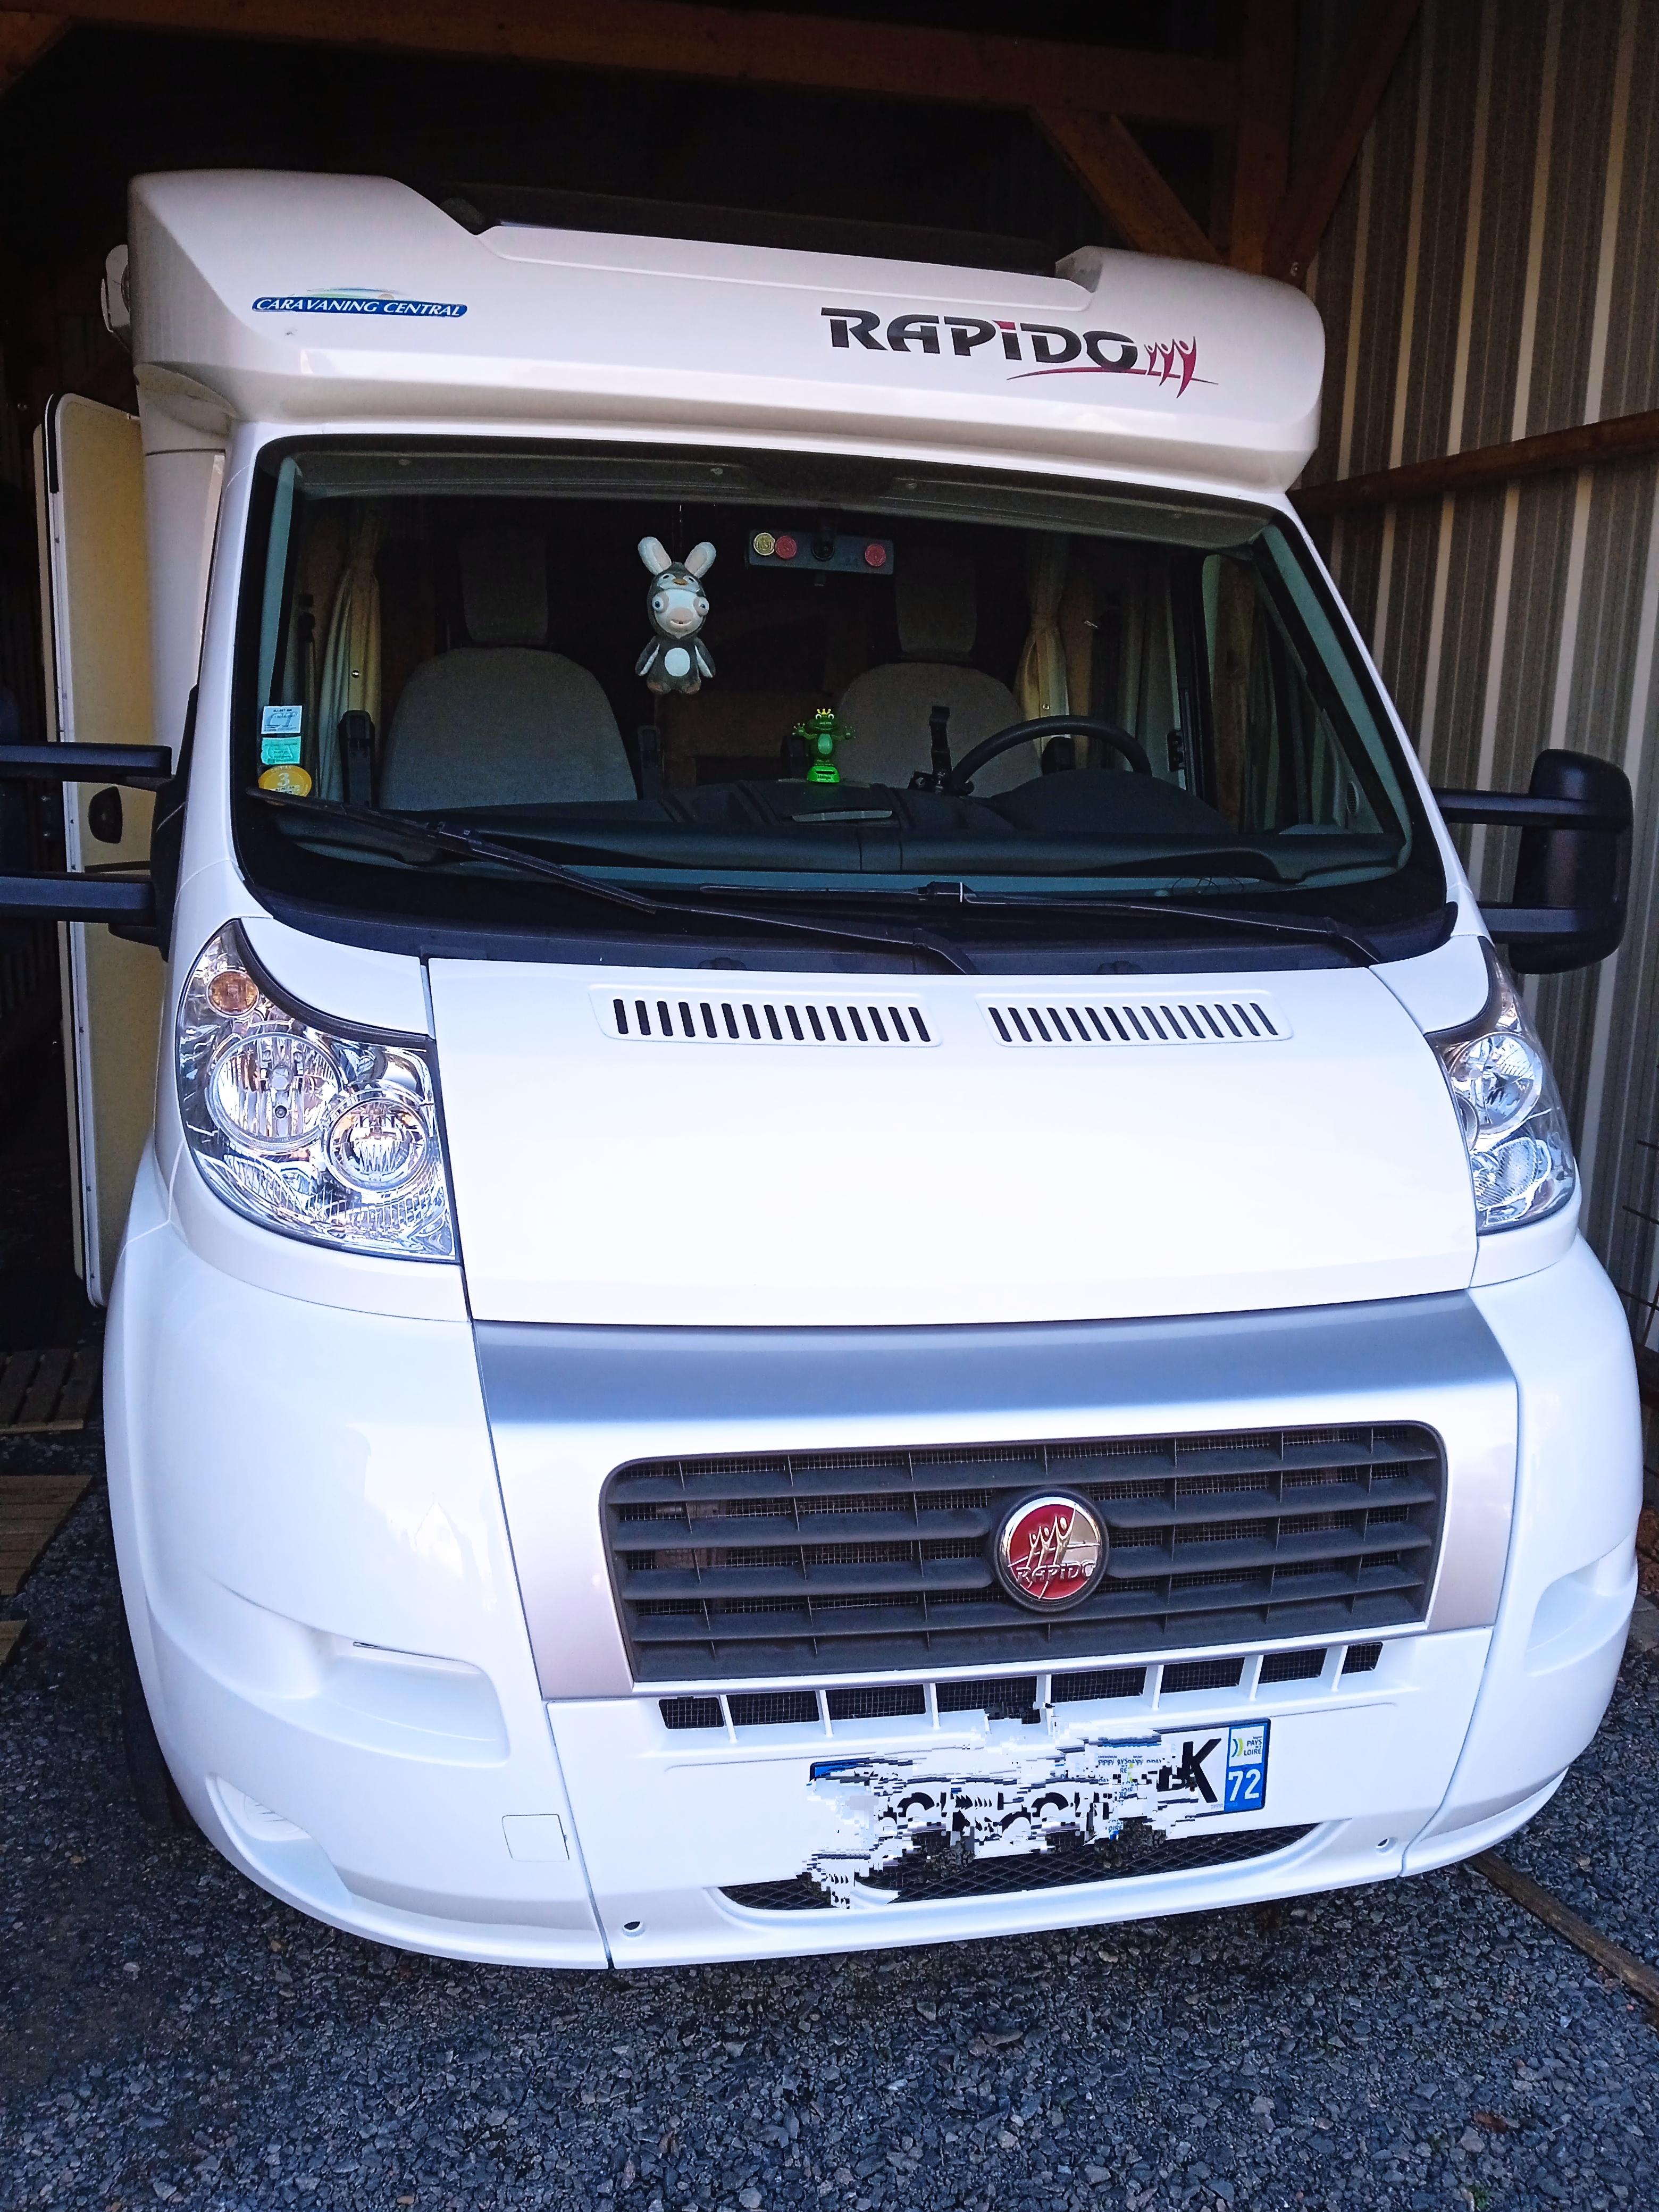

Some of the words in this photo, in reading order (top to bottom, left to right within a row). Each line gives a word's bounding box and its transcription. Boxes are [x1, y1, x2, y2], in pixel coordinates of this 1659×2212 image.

[256, 298, 380, 313] CARAVANING
[383, 302, 461, 316] CENTRAL
[276, 772, 290, 786] 3
[1228, 1769, 1261, 1802] 72
